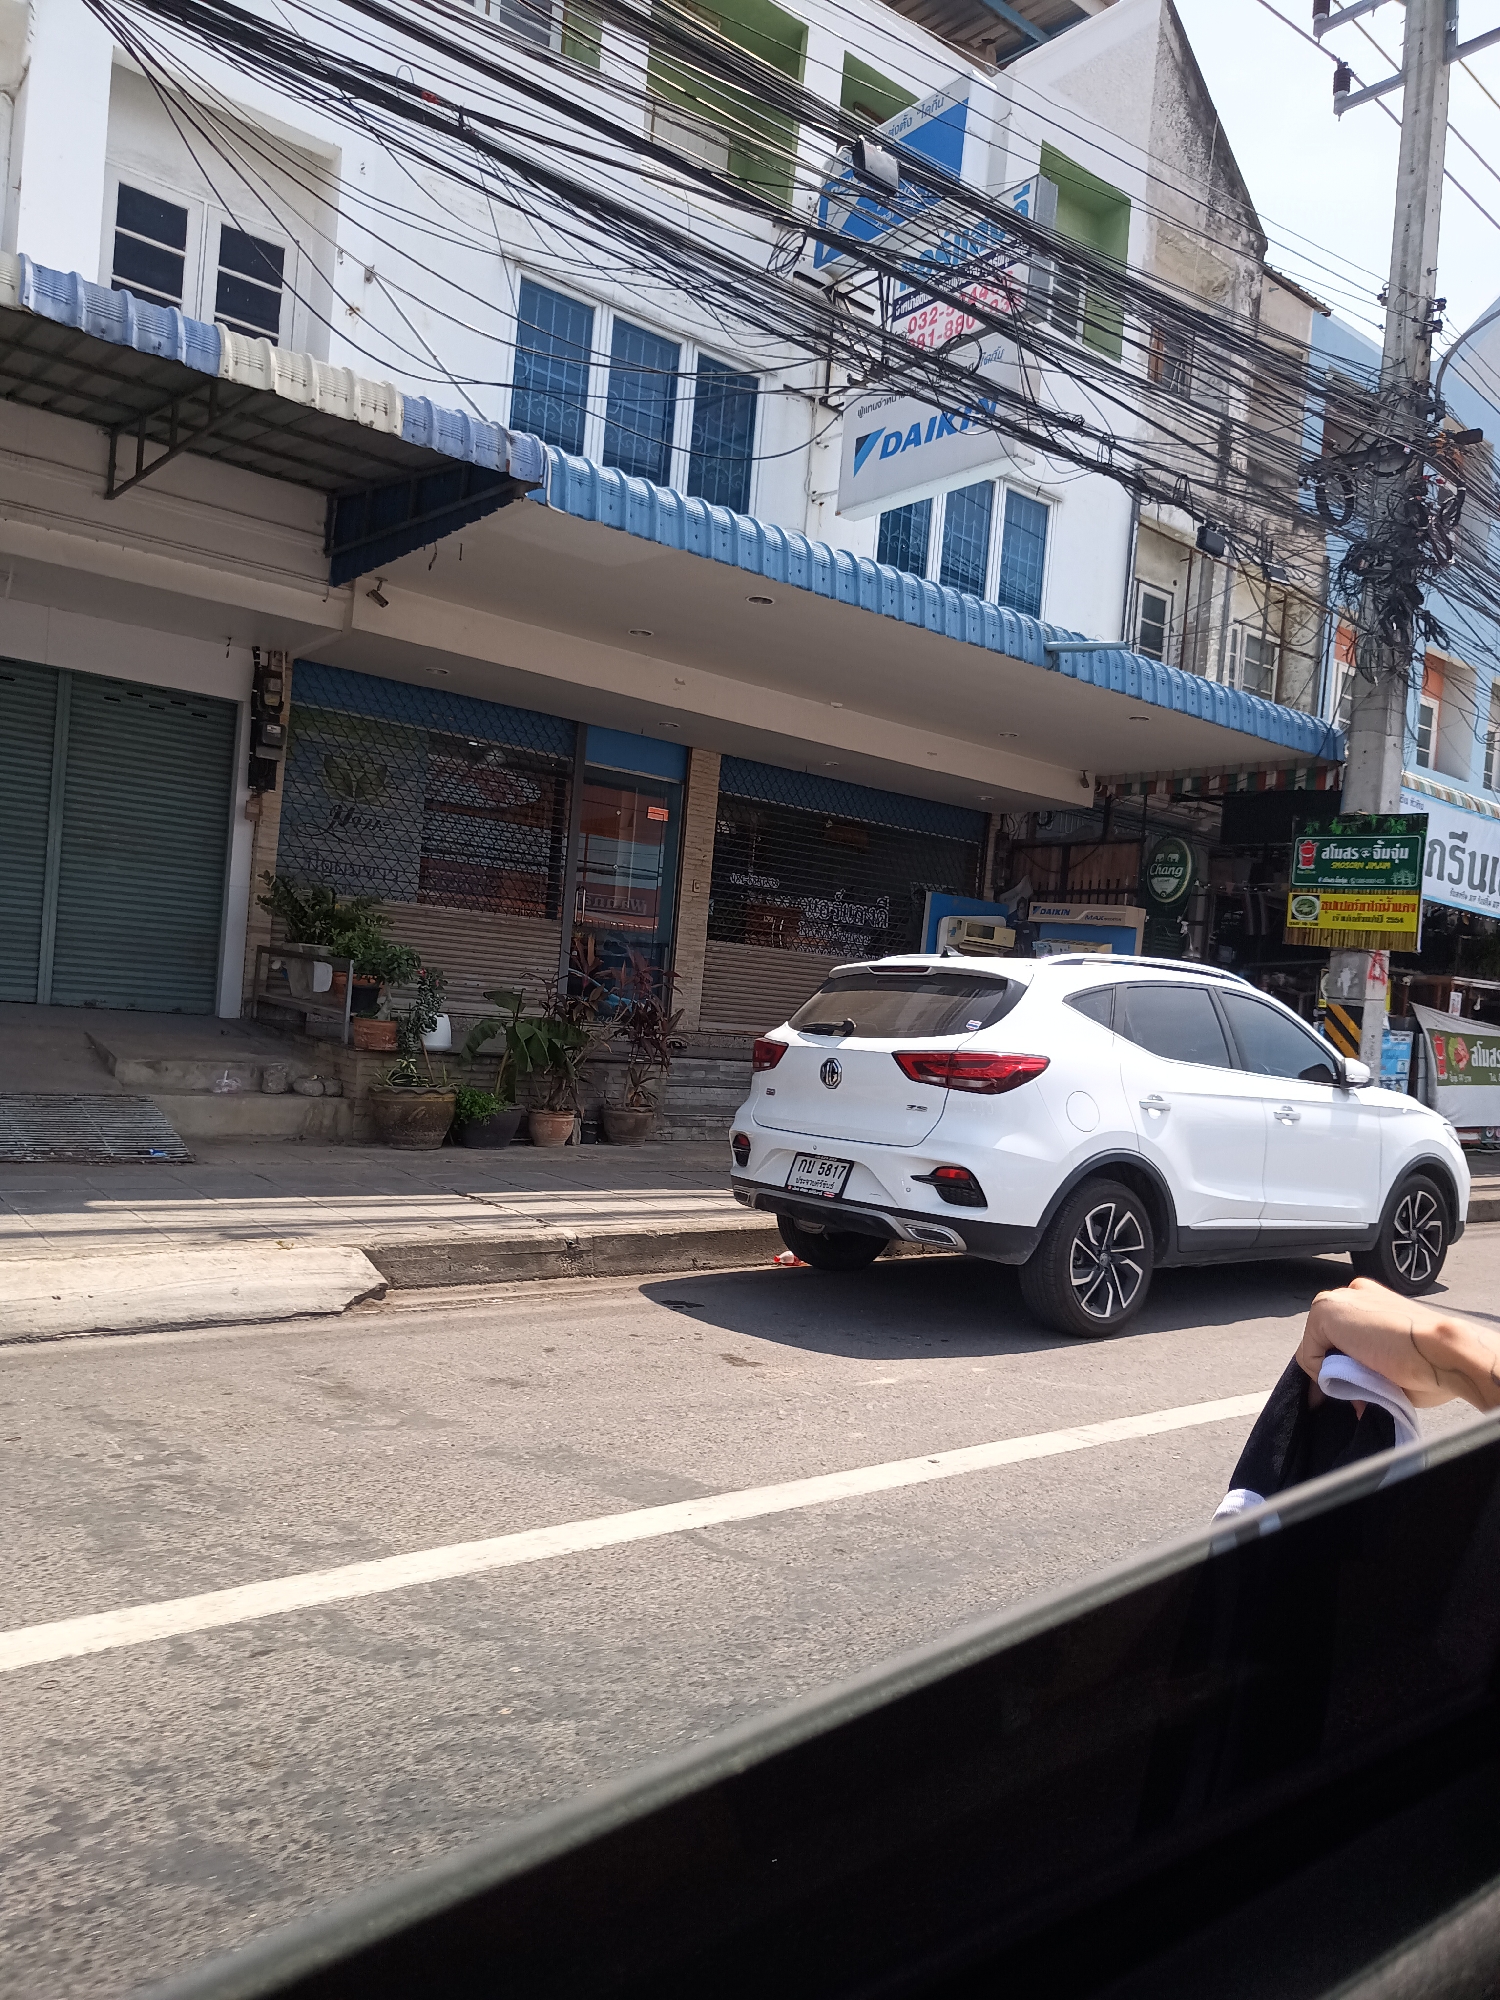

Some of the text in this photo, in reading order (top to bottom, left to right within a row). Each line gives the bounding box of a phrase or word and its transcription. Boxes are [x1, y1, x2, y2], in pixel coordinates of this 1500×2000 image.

[879, 398, 997, 460] DAIKIN
[1149, 863, 1184, 878] Chang
[1040, 908, 1071, 916] DAIKIN
[1470, 1040, 1500, 1068] สโมส
[818, 1162, 847, 1180] 5817
